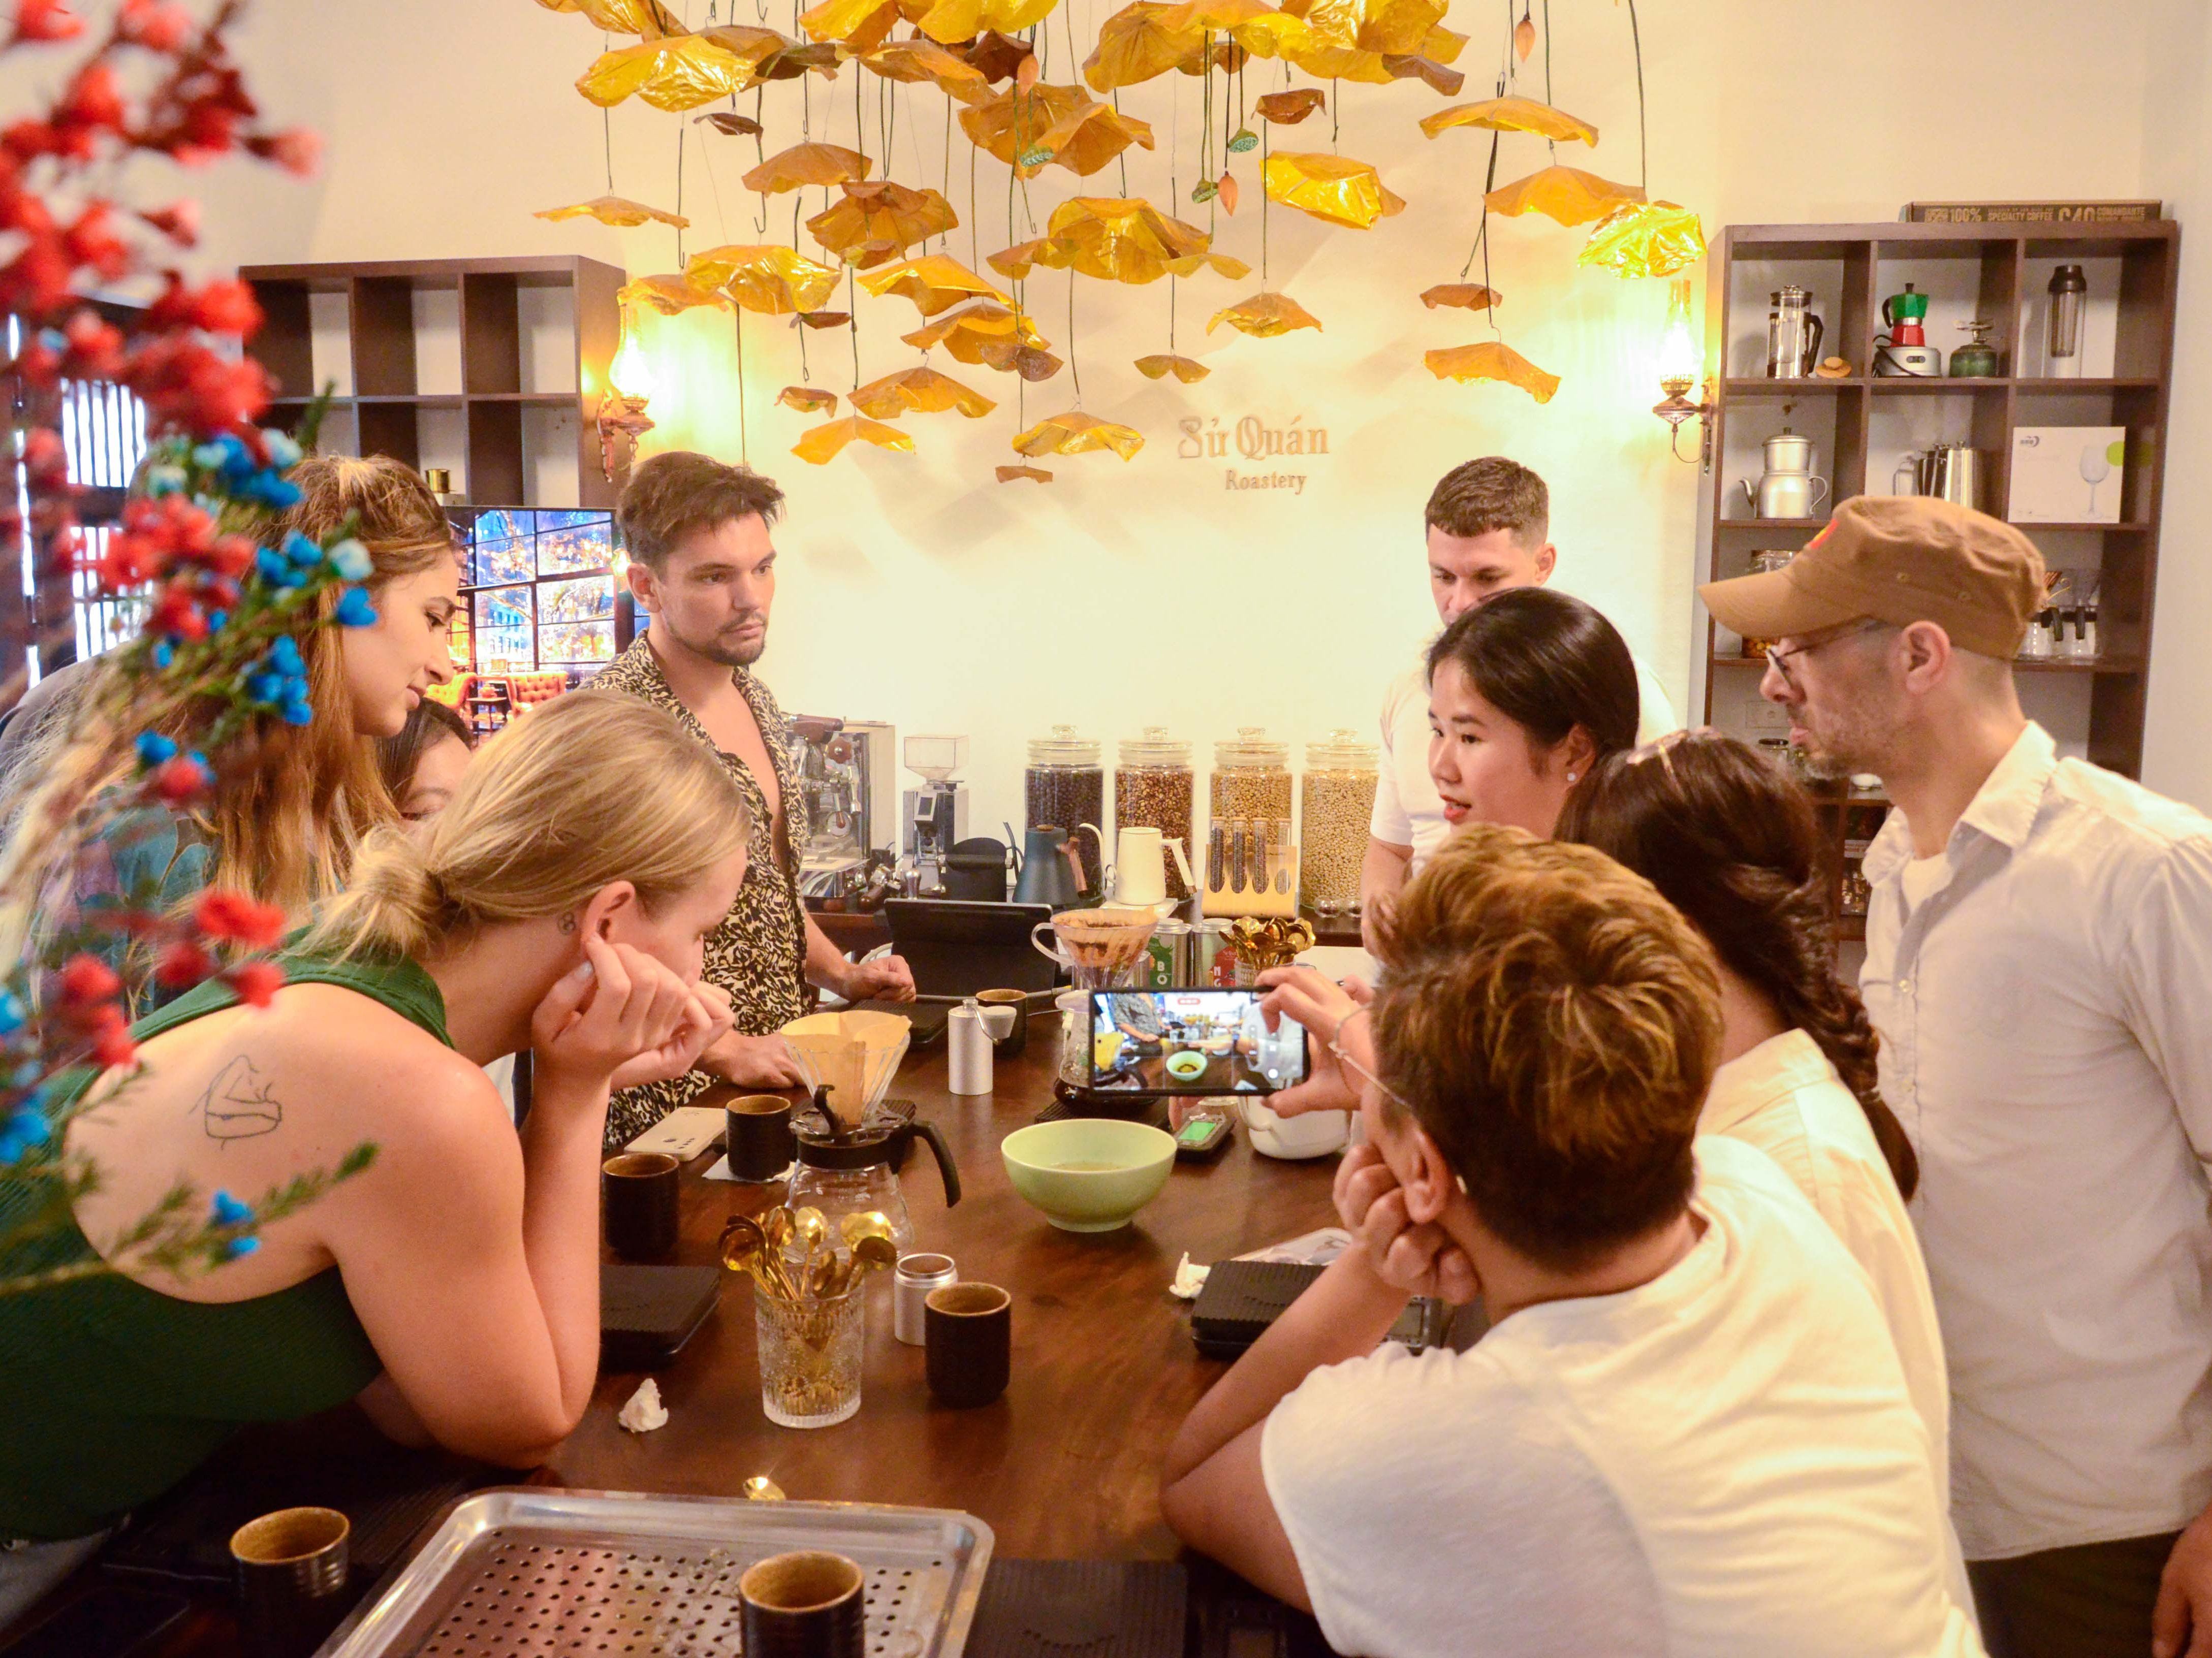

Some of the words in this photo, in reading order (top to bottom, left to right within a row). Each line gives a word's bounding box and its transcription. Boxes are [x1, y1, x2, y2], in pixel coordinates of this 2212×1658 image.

[1950, 208, 1982, 222] 100%
[1236, 414, 1330, 461] Quán
[1225, 469, 1307, 495] Roastery
